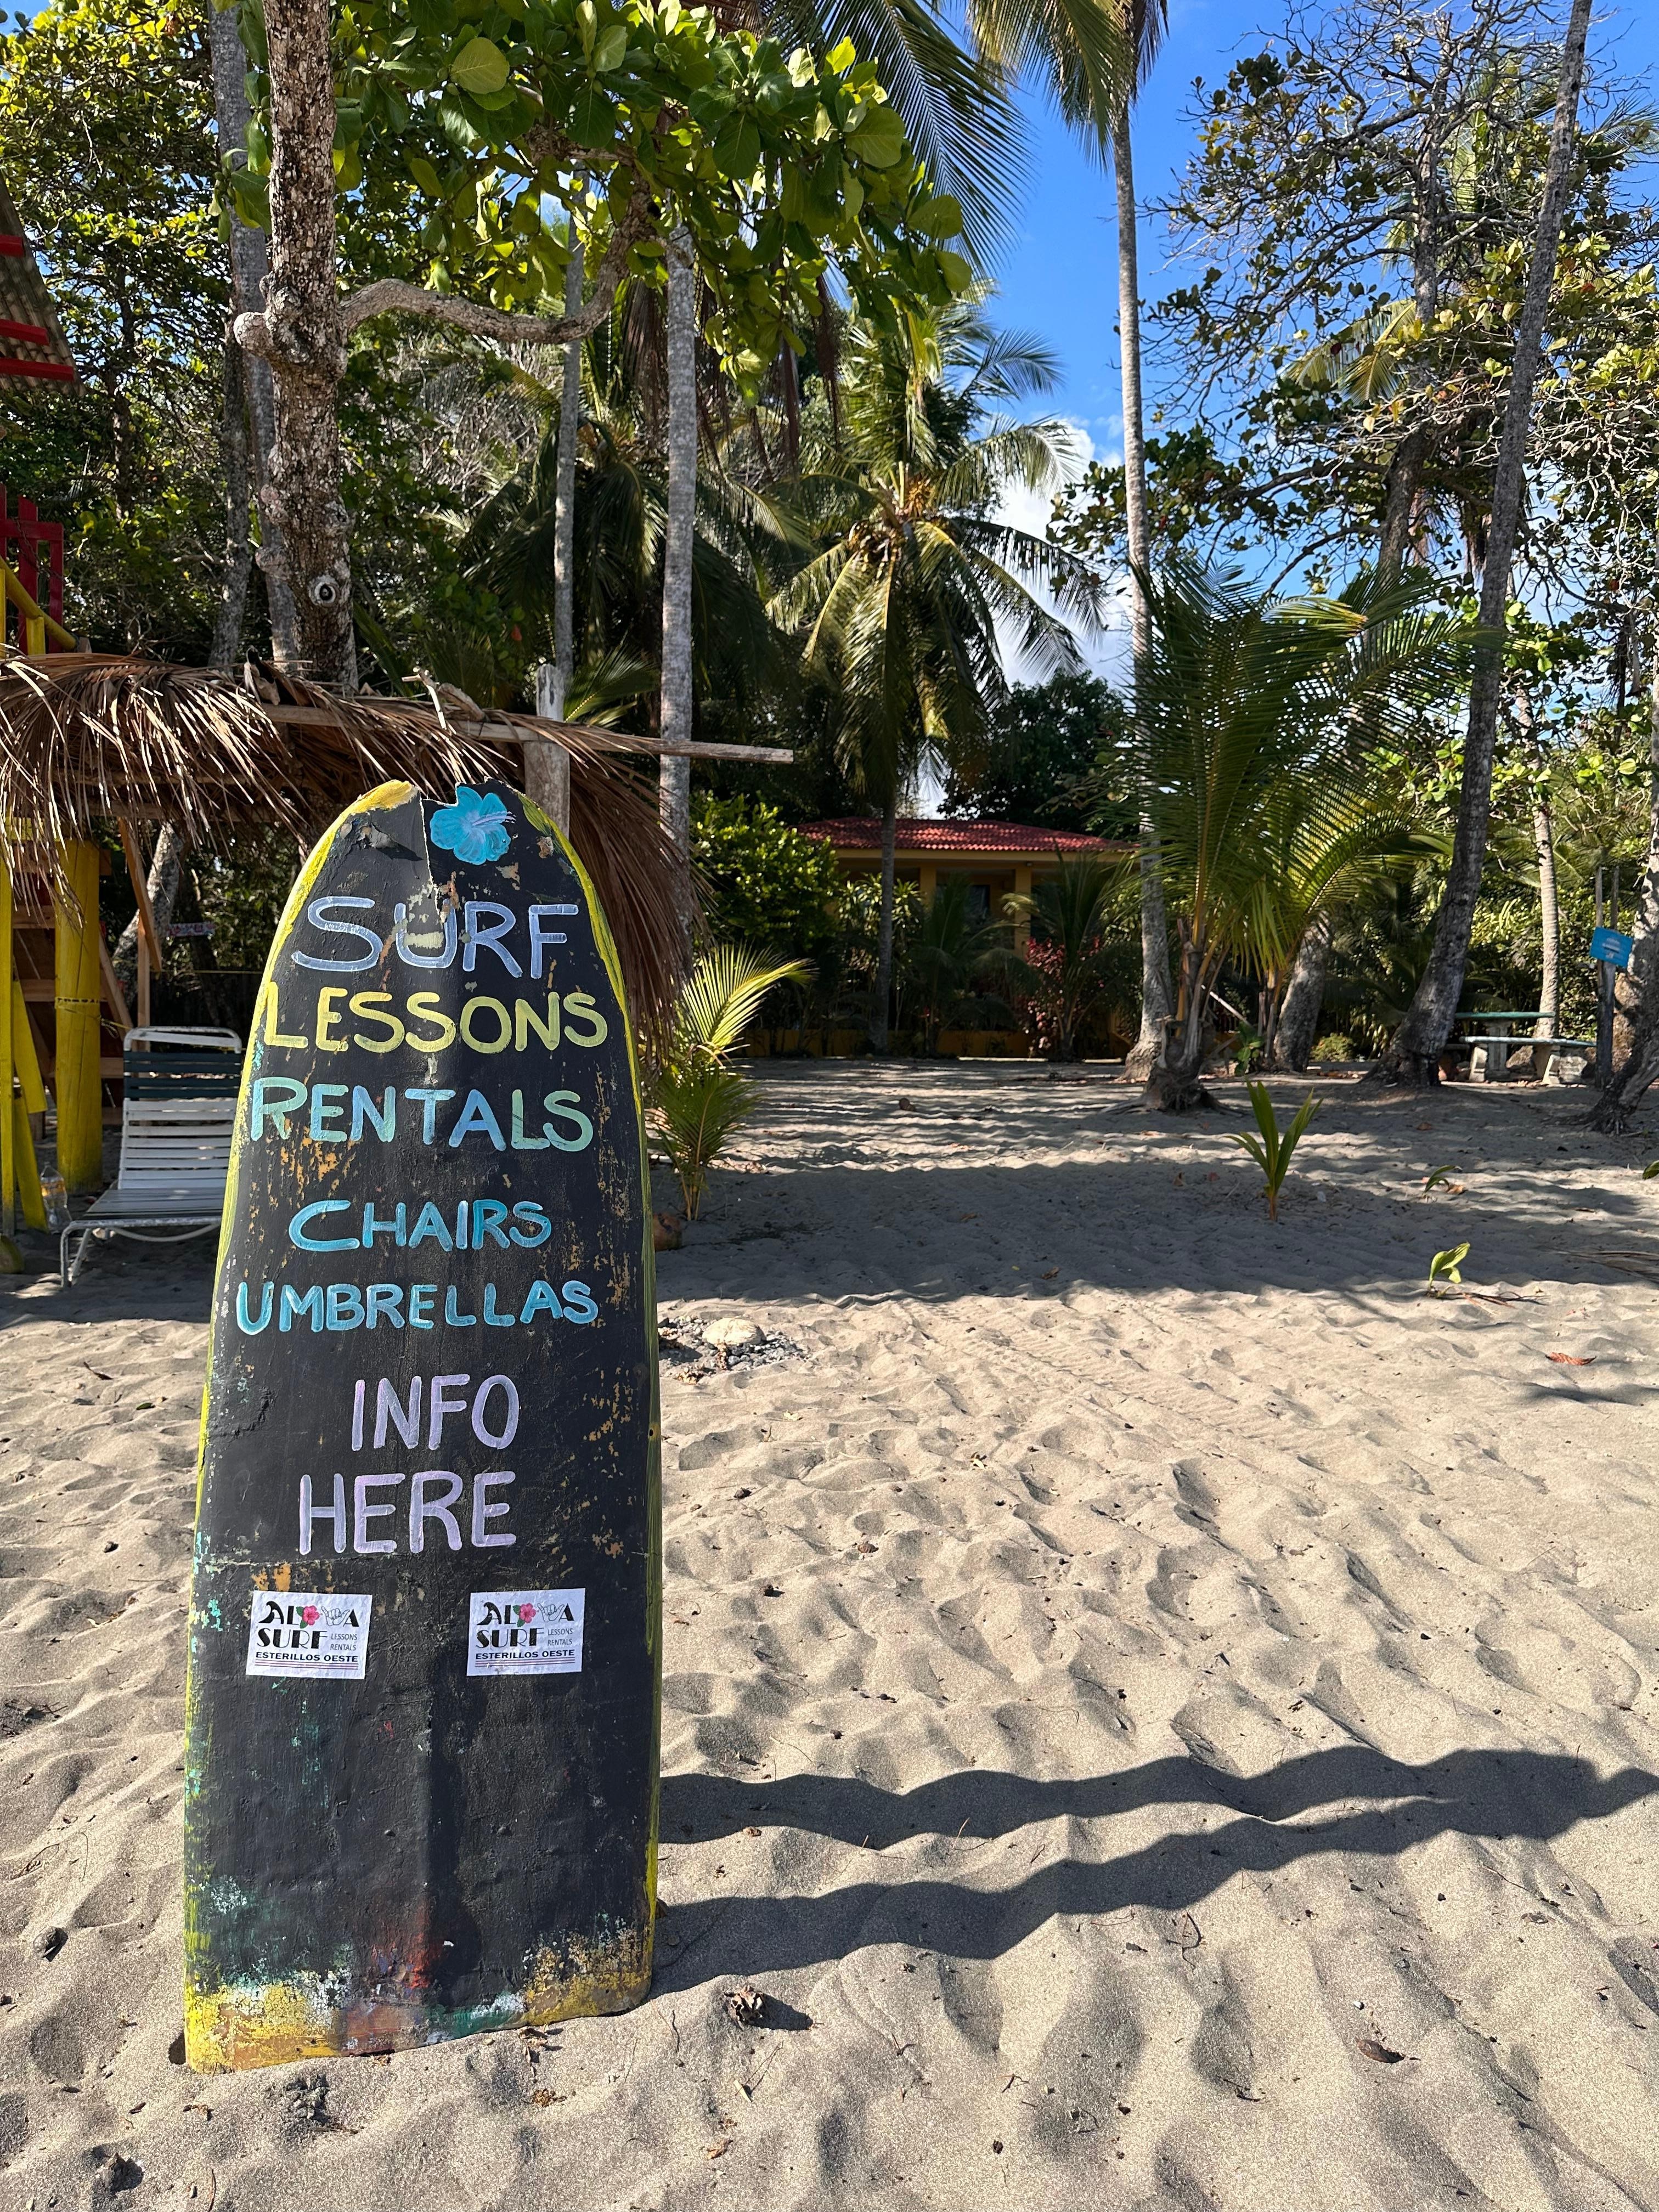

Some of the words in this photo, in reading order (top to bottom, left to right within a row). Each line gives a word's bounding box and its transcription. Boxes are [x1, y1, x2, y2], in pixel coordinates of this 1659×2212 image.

[291, 896, 578, 979] SURF
[262, 982, 608, 1053] LESSONS
[251, 1077, 594, 1152] RENTALS
[289, 1199, 551, 1252] CHAIRS
[236, 1280, 599, 1335] UMBRELLAS
[352, 1374, 519, 1451] INFO
[300, 1471, 516, 1555] HERE
[257, 1628, 328, 1649] SURF
[258, 1601, 359, 1627] ALA
[476, 1628, 544, 1648] SURF
[477, 1602, 574, 1627] ALA
[256, 1652, 320, 1661] ESTERILLOS
[476, 1651, 538, 1660] ESTERILLOS
